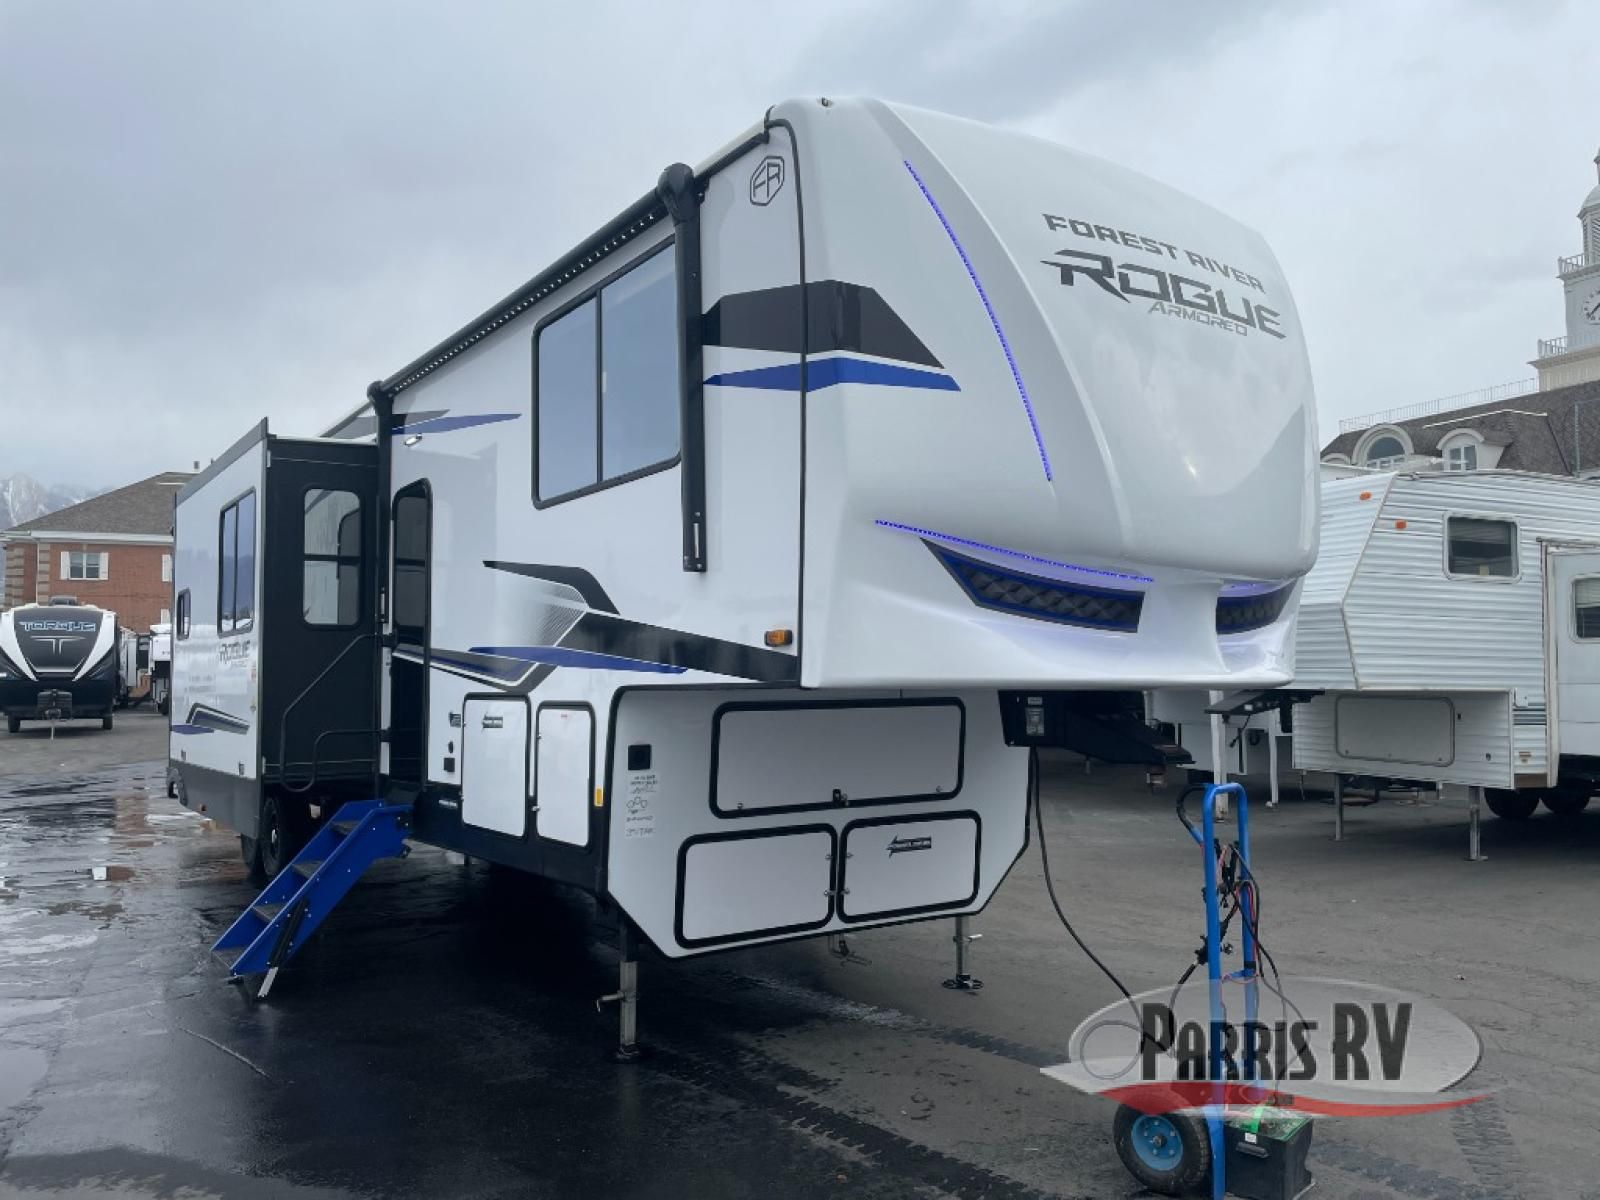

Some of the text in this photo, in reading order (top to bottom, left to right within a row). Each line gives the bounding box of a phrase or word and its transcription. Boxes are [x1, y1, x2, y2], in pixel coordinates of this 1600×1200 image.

[1040, 248, 1287, 340] ROGUE
[1042, 213, 1266, 294] FOREST RIVER
[1148, 301, 1248, 336] ARMORED
